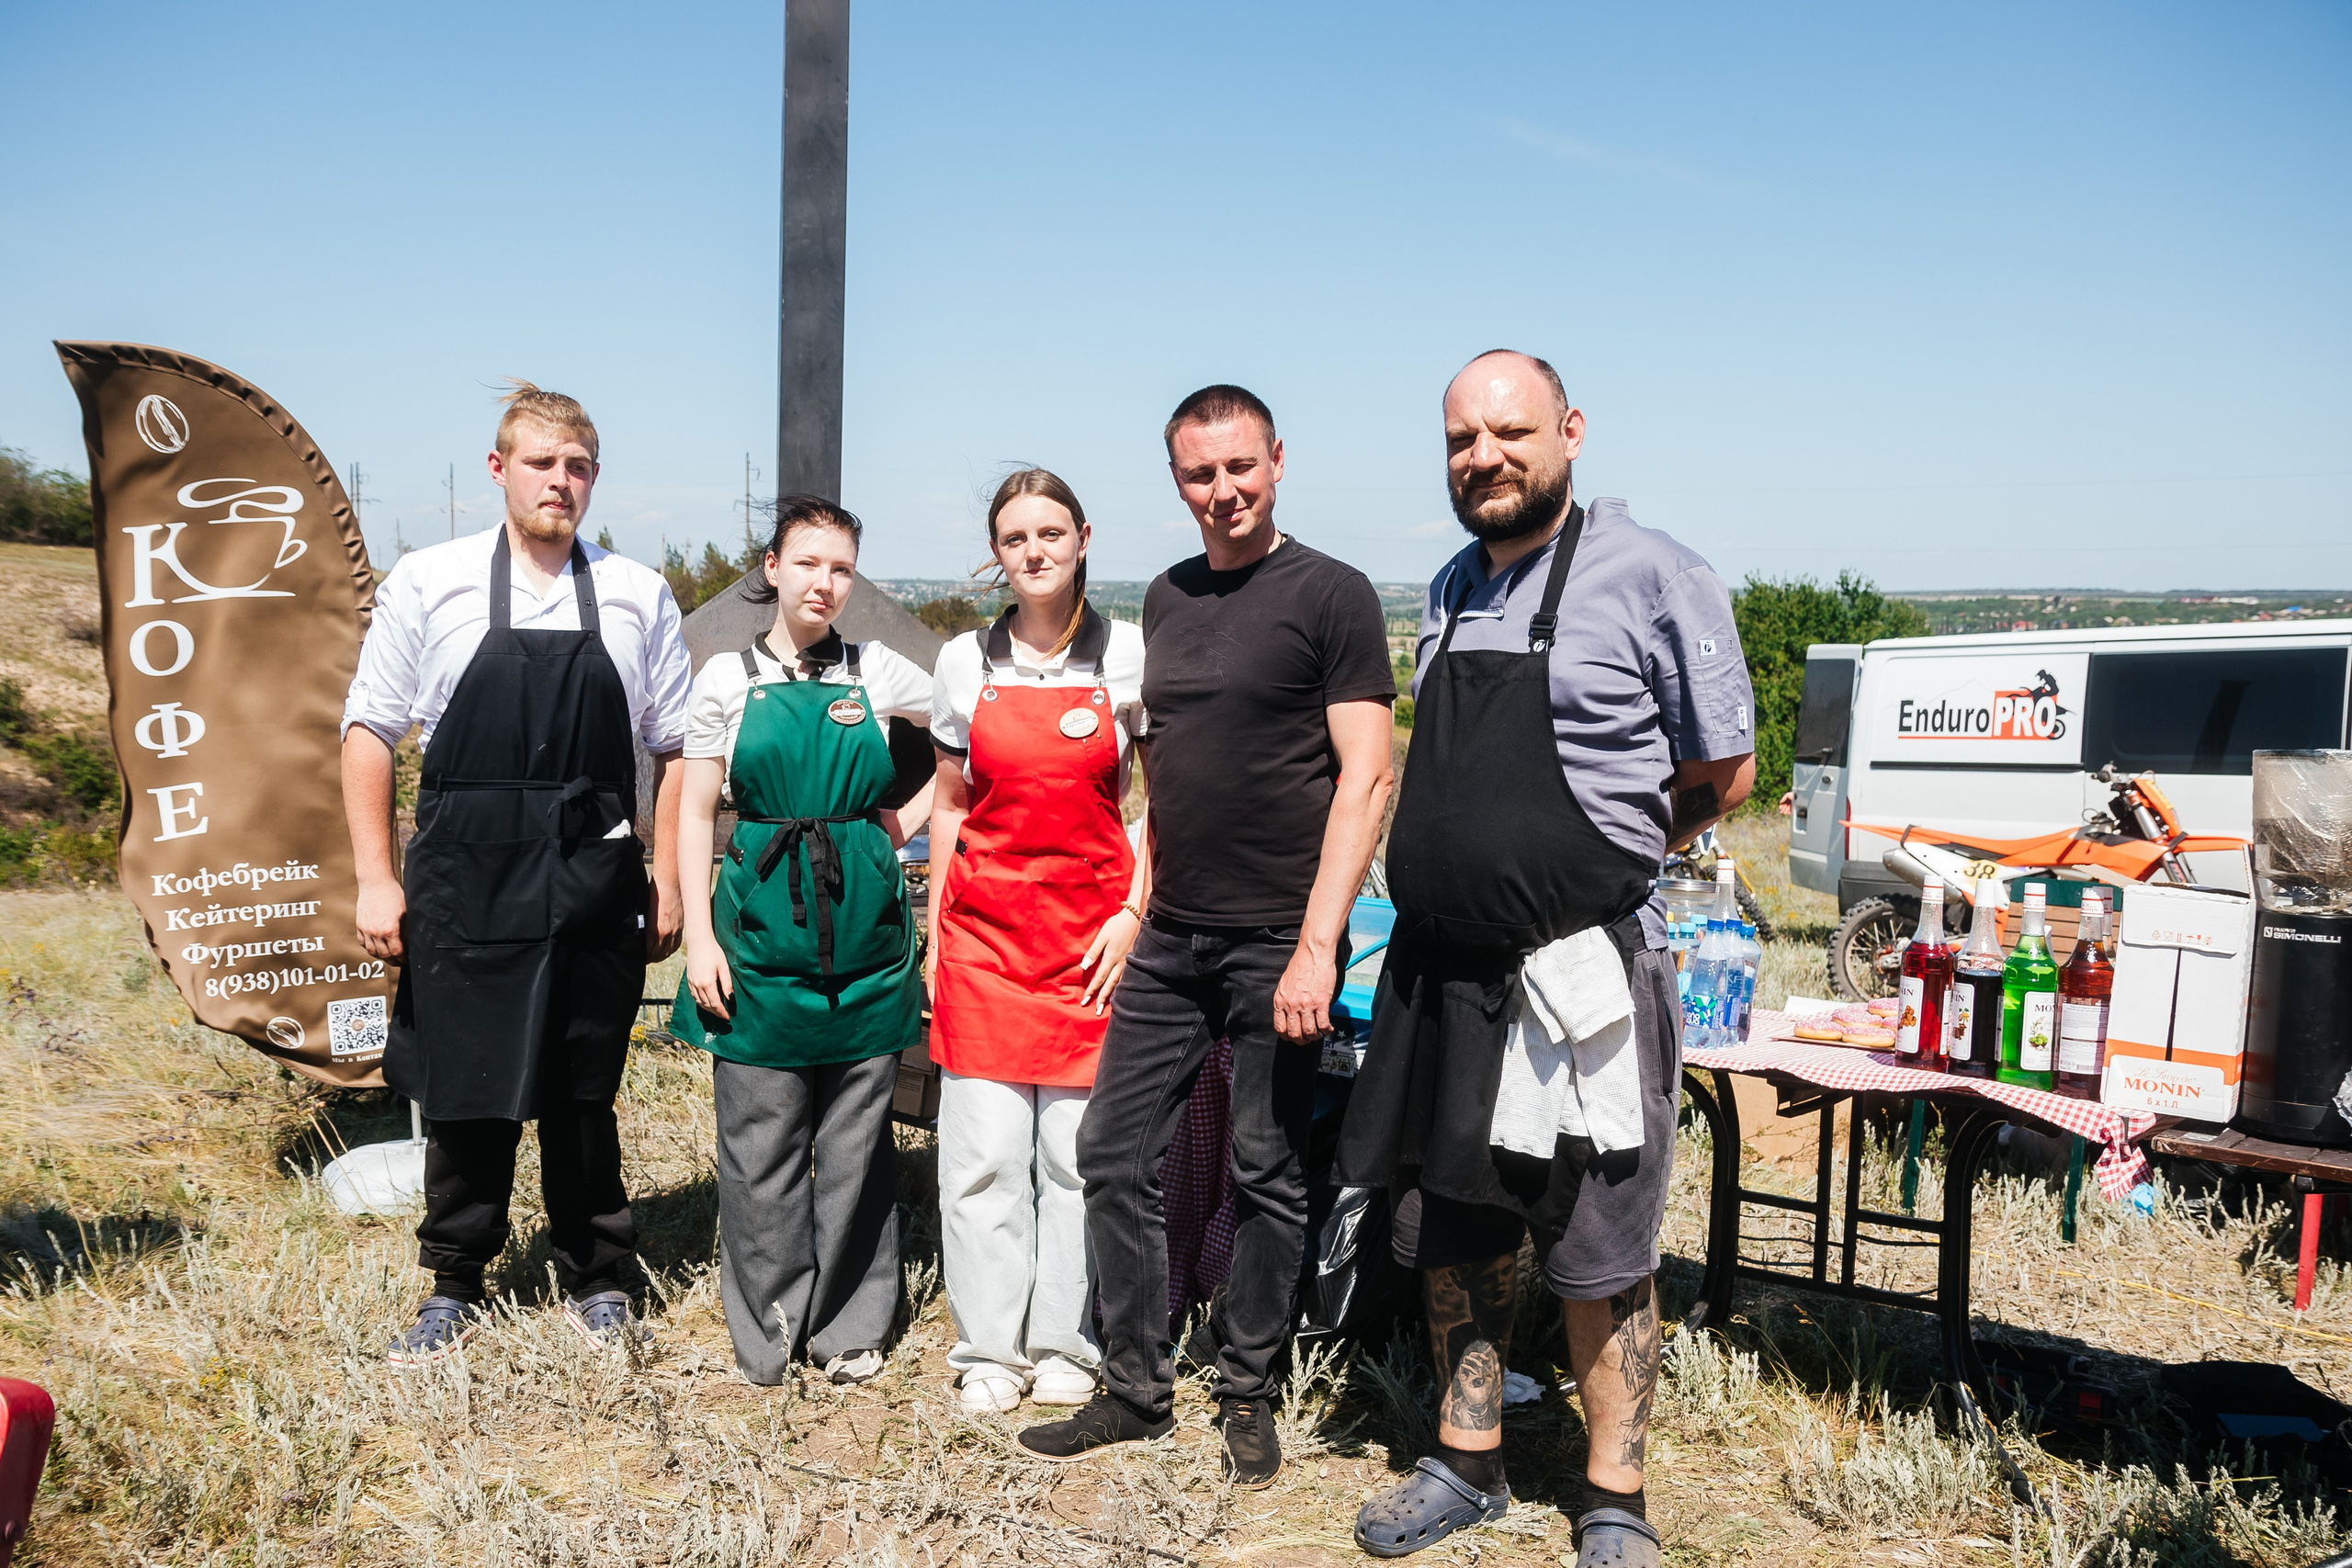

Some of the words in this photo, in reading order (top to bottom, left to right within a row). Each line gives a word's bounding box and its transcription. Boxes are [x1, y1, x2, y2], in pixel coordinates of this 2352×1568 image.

[1898, 695, 2057, 739] EnduroPRO
[151, 860, 320, 897] Кофебрейк
[164, 899, 322, 931] Кейтеринг
[181, 936, 325, 969] Фуршеты
[2273, 931, 2342, 943] SIMONELLI
[205, 961, 385, 1000] 8(938)101-01-02
[2123, 1077, 2201, 1099] MONIN
